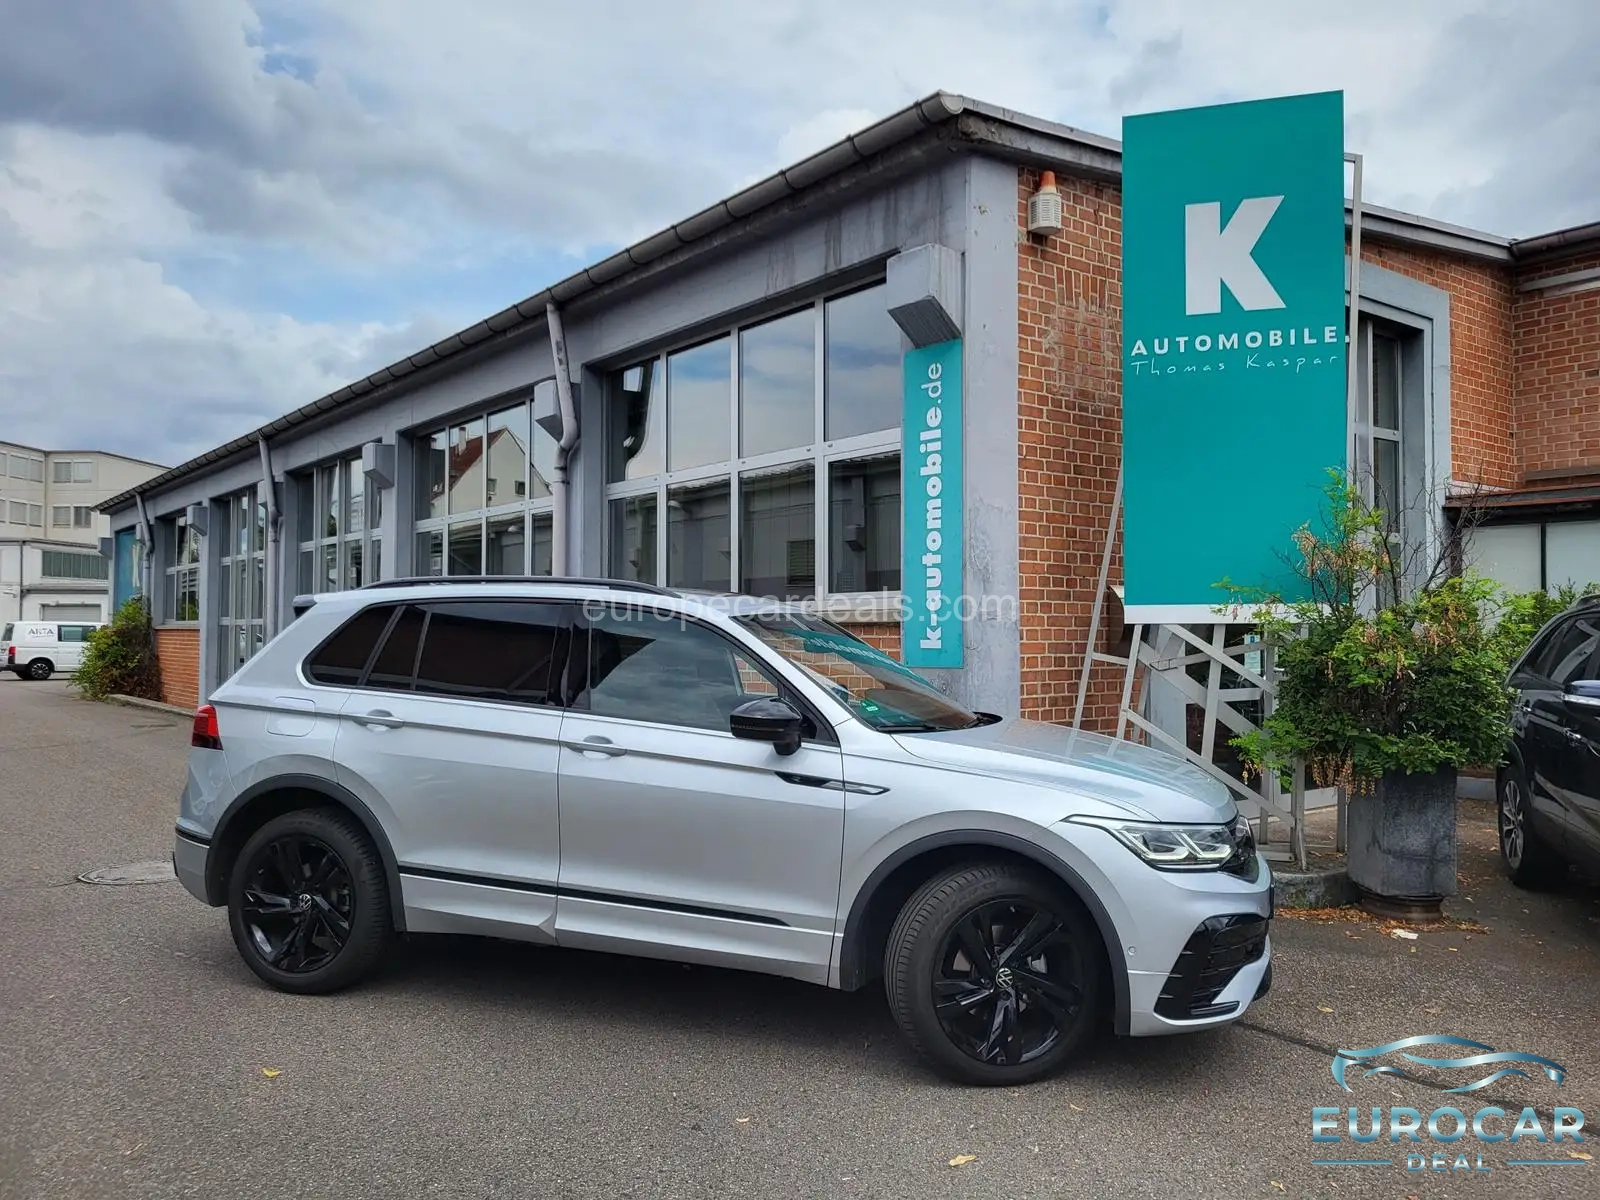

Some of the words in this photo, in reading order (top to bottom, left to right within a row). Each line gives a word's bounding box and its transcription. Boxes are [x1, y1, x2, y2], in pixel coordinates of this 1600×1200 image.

[1185, 195, 1287, 315] K
[1130, 357, 1225, 375] Thomas
[1246, 352, 1340, 374] Kaspar
[1131, 326, 1338, 356] AUTOMOBILE
[919, 362, 942, 649] k-automobile.de
